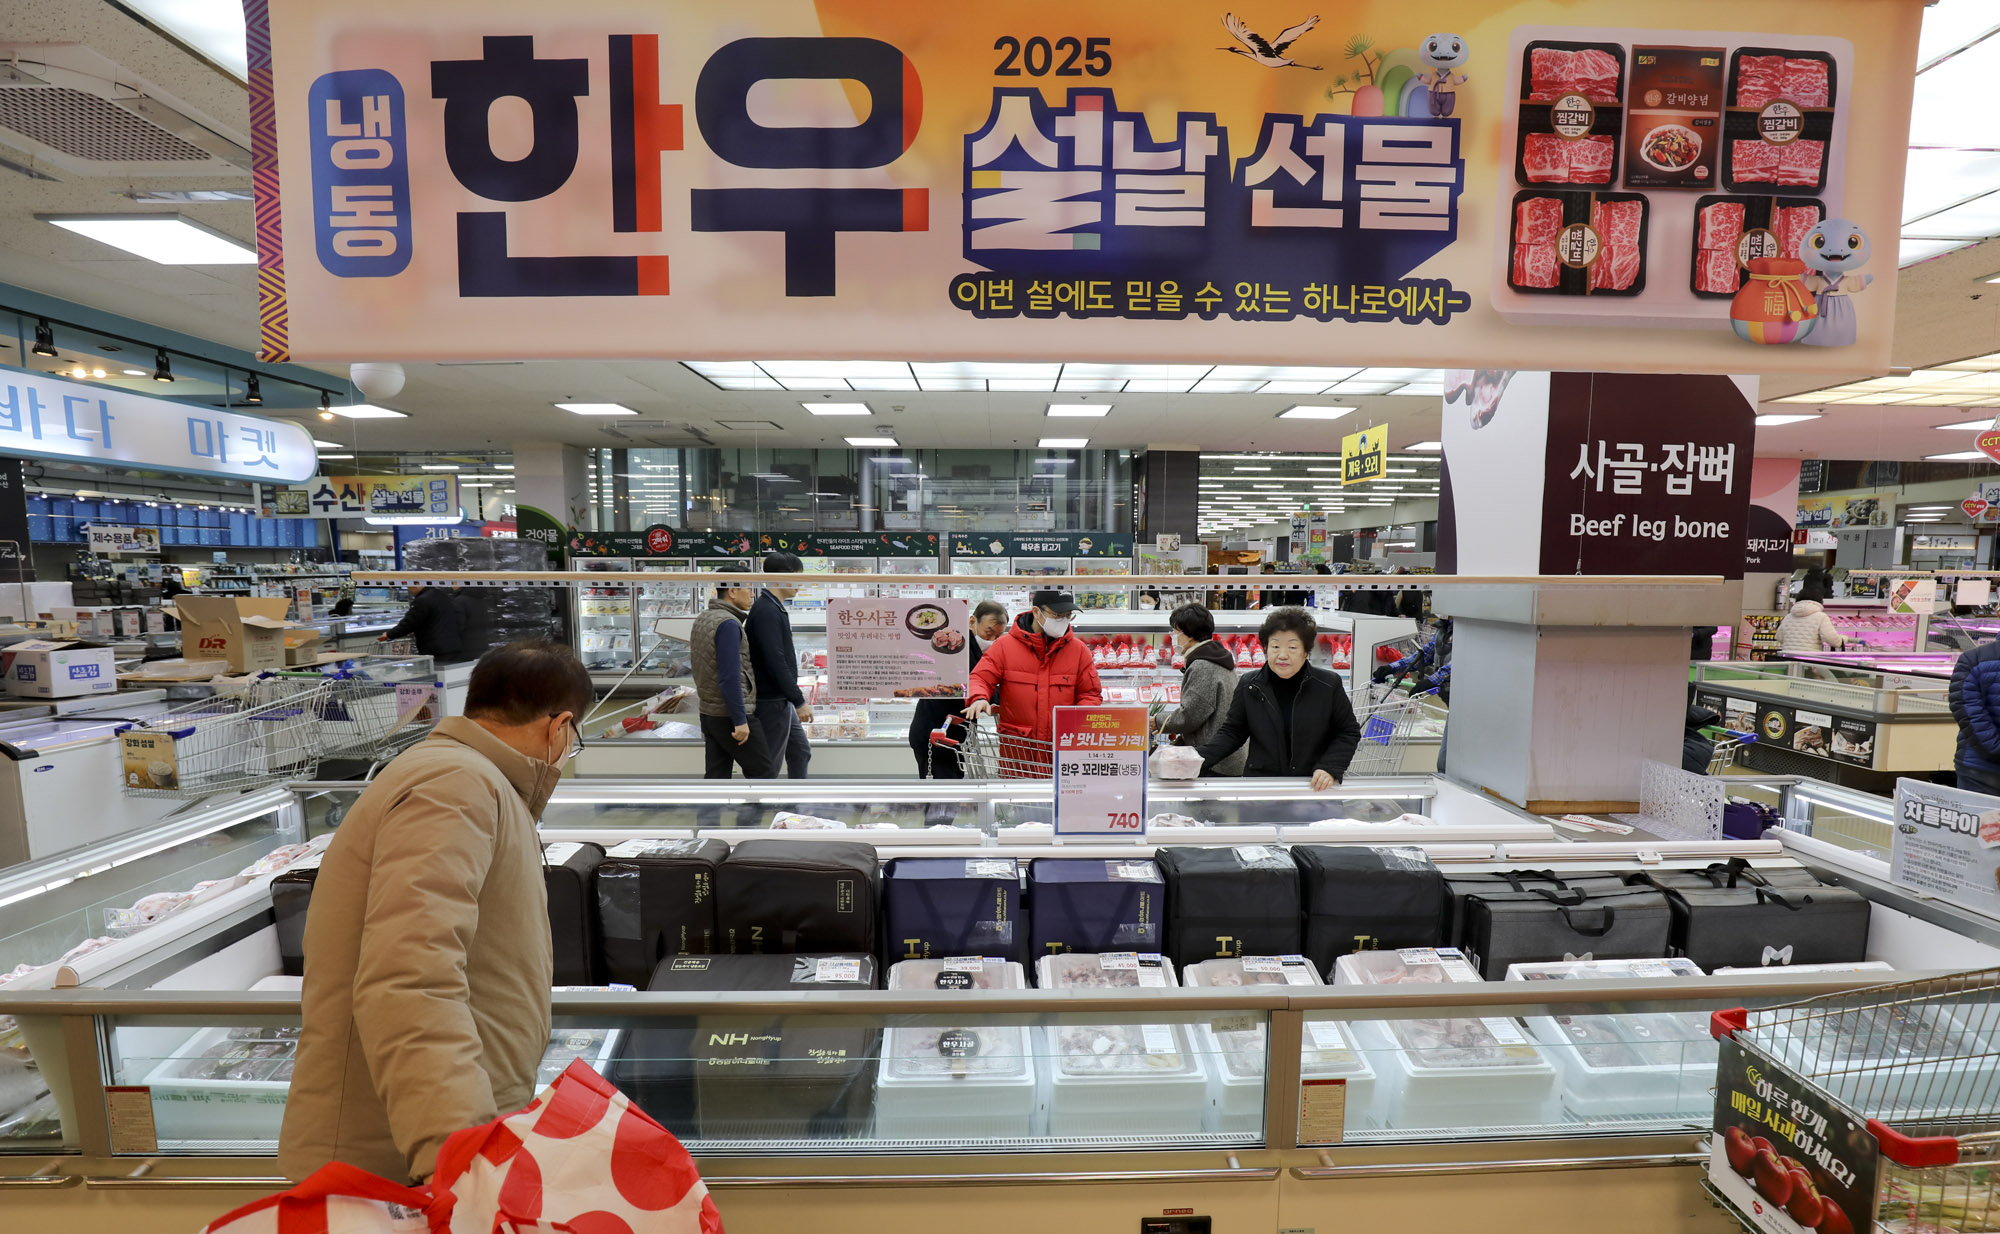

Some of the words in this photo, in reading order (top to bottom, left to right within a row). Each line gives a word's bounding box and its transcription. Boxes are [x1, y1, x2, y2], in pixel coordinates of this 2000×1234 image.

[993, 36, 1112, 77] 2025
[1667, 92, 1708, 106] 갈비양념
[1556, 112, 1589, 125] 찜갈비
[1763, 118, 1797, 130] 찜갈비
[430, 34, 930, 298] 한우
[970, 94, 1218, 251] 설날
[1244, 121, 1457, 232] 선물
[326, 94, 398, 258] 냉동
[1570, 230, 1582, 262] 찜갈비
[1750, 235, 1762, 258] 찜갈
[956, 281, 1014, 311] 이번
[1026, 280, 1114, 312] 설에도
[1126, 280, 1183, 313] 믿을
[1194, 281, 1223, 313] 수
[1235, 283, 1291, 314] 있는
[1764, 291, 1785, 316] 福
[0, 385, 115, 449] 바다
[187, 417, 279, 470] 마켓
[1981, 436, 2000, 447] CCT
[1569, 439, 1736, 495] 사골·잡뼈
[313, 482, 365, 513] 수산
[371, 489, 399, 507] 설날
[400, 489, 425, 505] 선물
[1570, 514, 1621, 537] Beef
[1632, 513, 1667, 541] leg
[1674, 513, 1730, 538] bone
[92, 532, 133, 544] 제수용품
[525, 529, 559, 543] 건어물
[1021, 543, 1040, 551] 목우촌
[1042, 543, 1061, 551] 닭고기
[1746, 538, 1789, 553] 돼지고기
[1746, 556, 1761, 564] Pork
[838, 609, 897, 626] 한우사골
[125, 738, 140, 748] 강화
[1059, 733, 1075, 747] 살
[1076, 733, 1118, 747] 맛나는
[1119, 735, 1145, 747] 가격!
[1060, 763, 1080, 776] 한우
[1081, 763, 1142, 777] 꼬리반골(냉동)
[1107, 812, 1140, 829] 740
[1904, 800, 1980, 837] 차돌박이
[834, 972, 856, 980] 95,000
[708, 1033, 749, 1046] NH
[1755, 1078, 1789, 1110] 하루
[1790, 1098, 1829, 1142] 한개,
[1730, 1089, 1763, 1123] 매일
[1763, 1107, 1857, 1190] 사과하세요!
